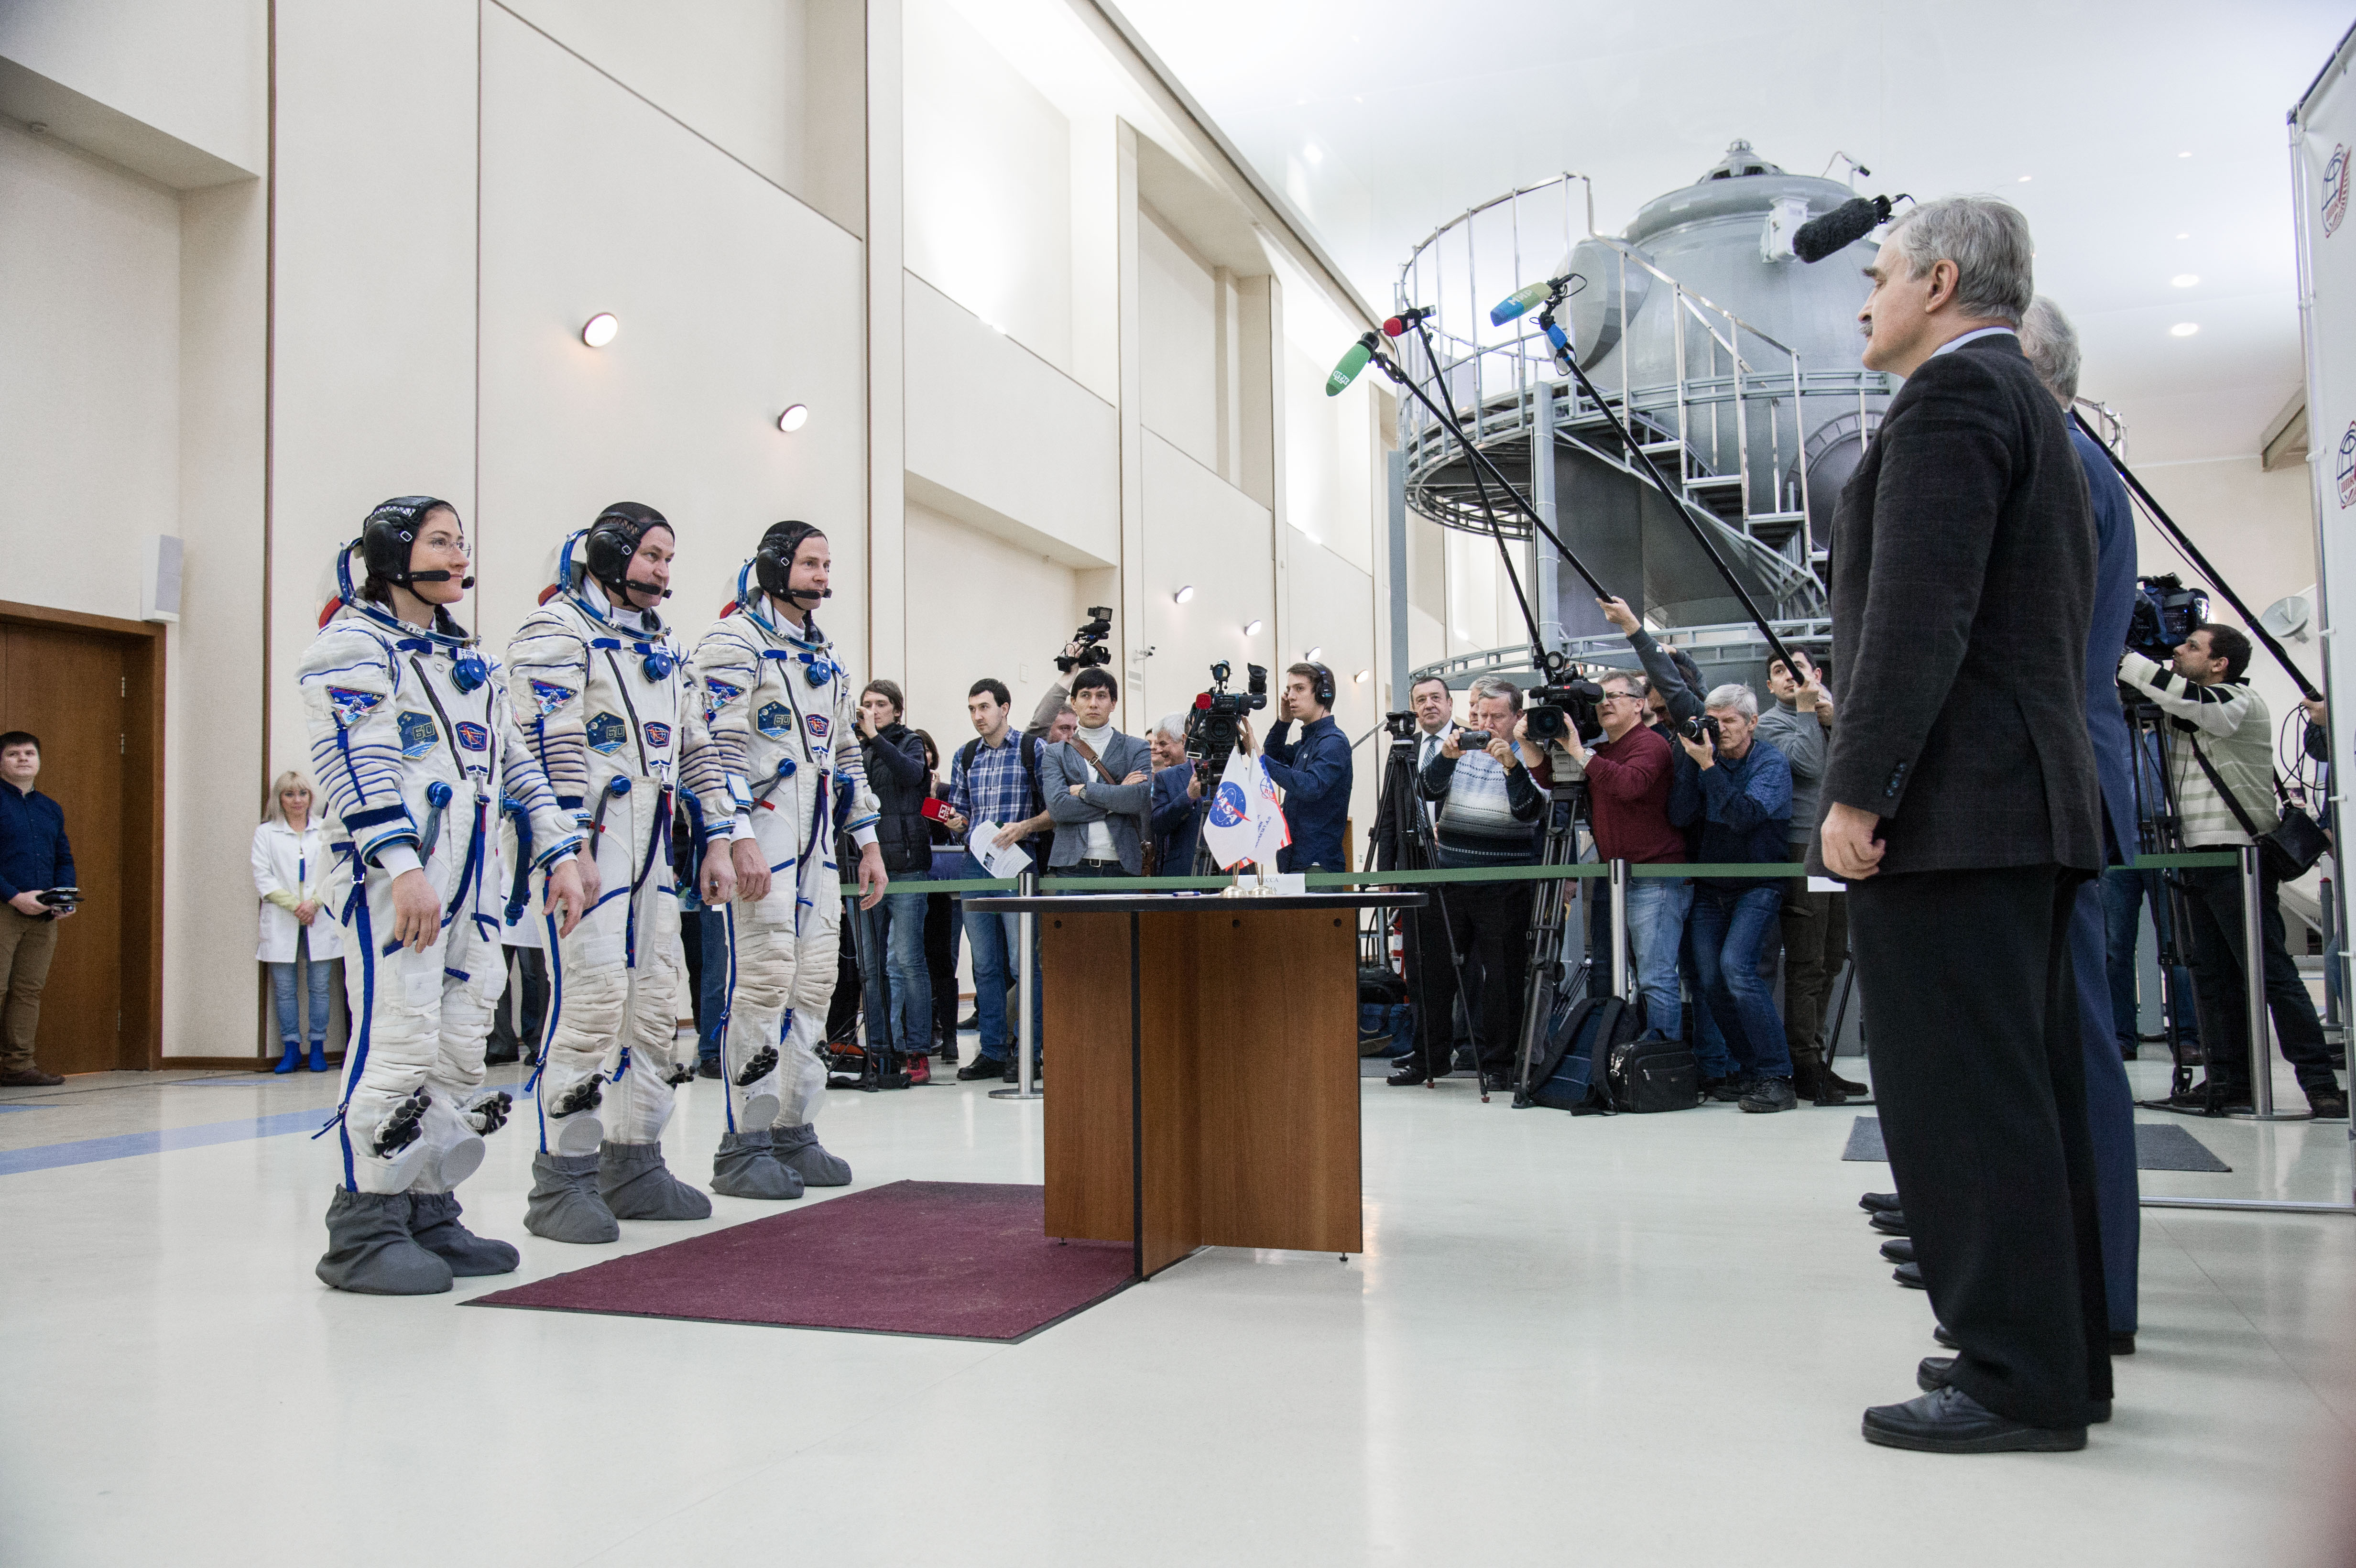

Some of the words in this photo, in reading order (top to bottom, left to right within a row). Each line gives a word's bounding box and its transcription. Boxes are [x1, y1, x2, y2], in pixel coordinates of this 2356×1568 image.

[1333, 370, 1350, 385] НТВ
[774, 714, 791, 725] 60
[413, 721, 435, 740] 60
[606, 724, 625, 739] 60
[1216, 786, 1238, 825] NASA
